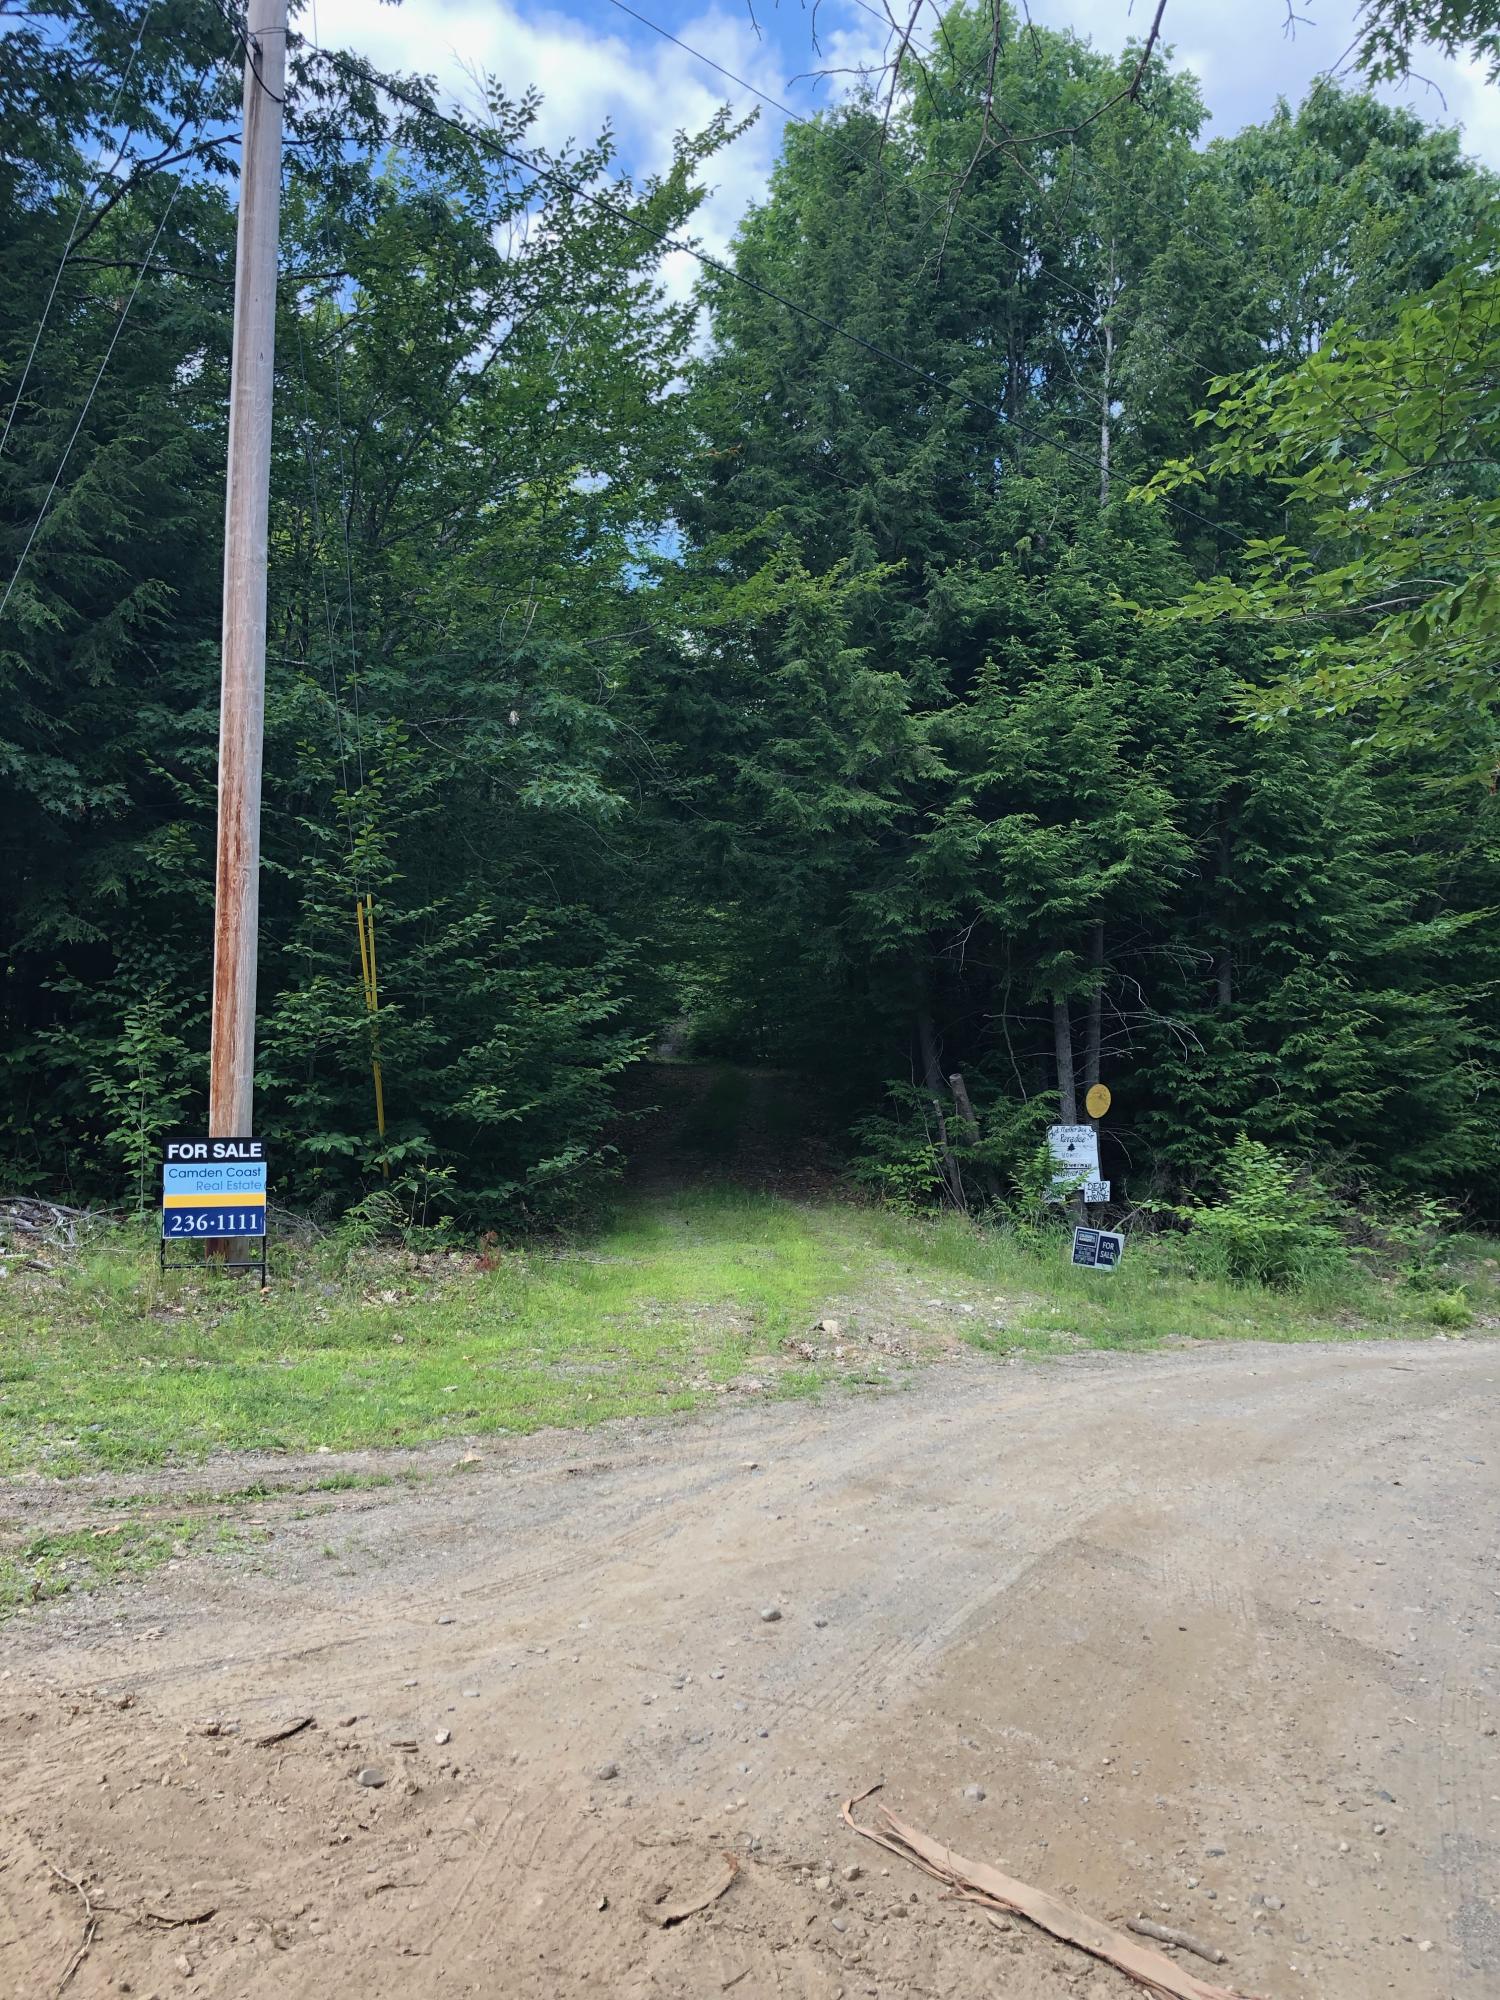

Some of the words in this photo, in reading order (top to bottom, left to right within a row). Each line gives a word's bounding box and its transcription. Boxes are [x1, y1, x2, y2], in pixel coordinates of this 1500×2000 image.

[168, 1144, 208, 1159] FOR
[213, 1143, 262, 1158] SALE
[169, 1168, 222, 1178] Camden
[226, 1167, 261, 1177] Coast
[196, 1181, 223, 1191] Real
[226, 1180, 261, 1190] Estate
[1087, 1182, 1108, 1191] DEAD
[1102, 1241, 1115, 1250] FOR
[1100, 1250, 1114, 1259] SALE
